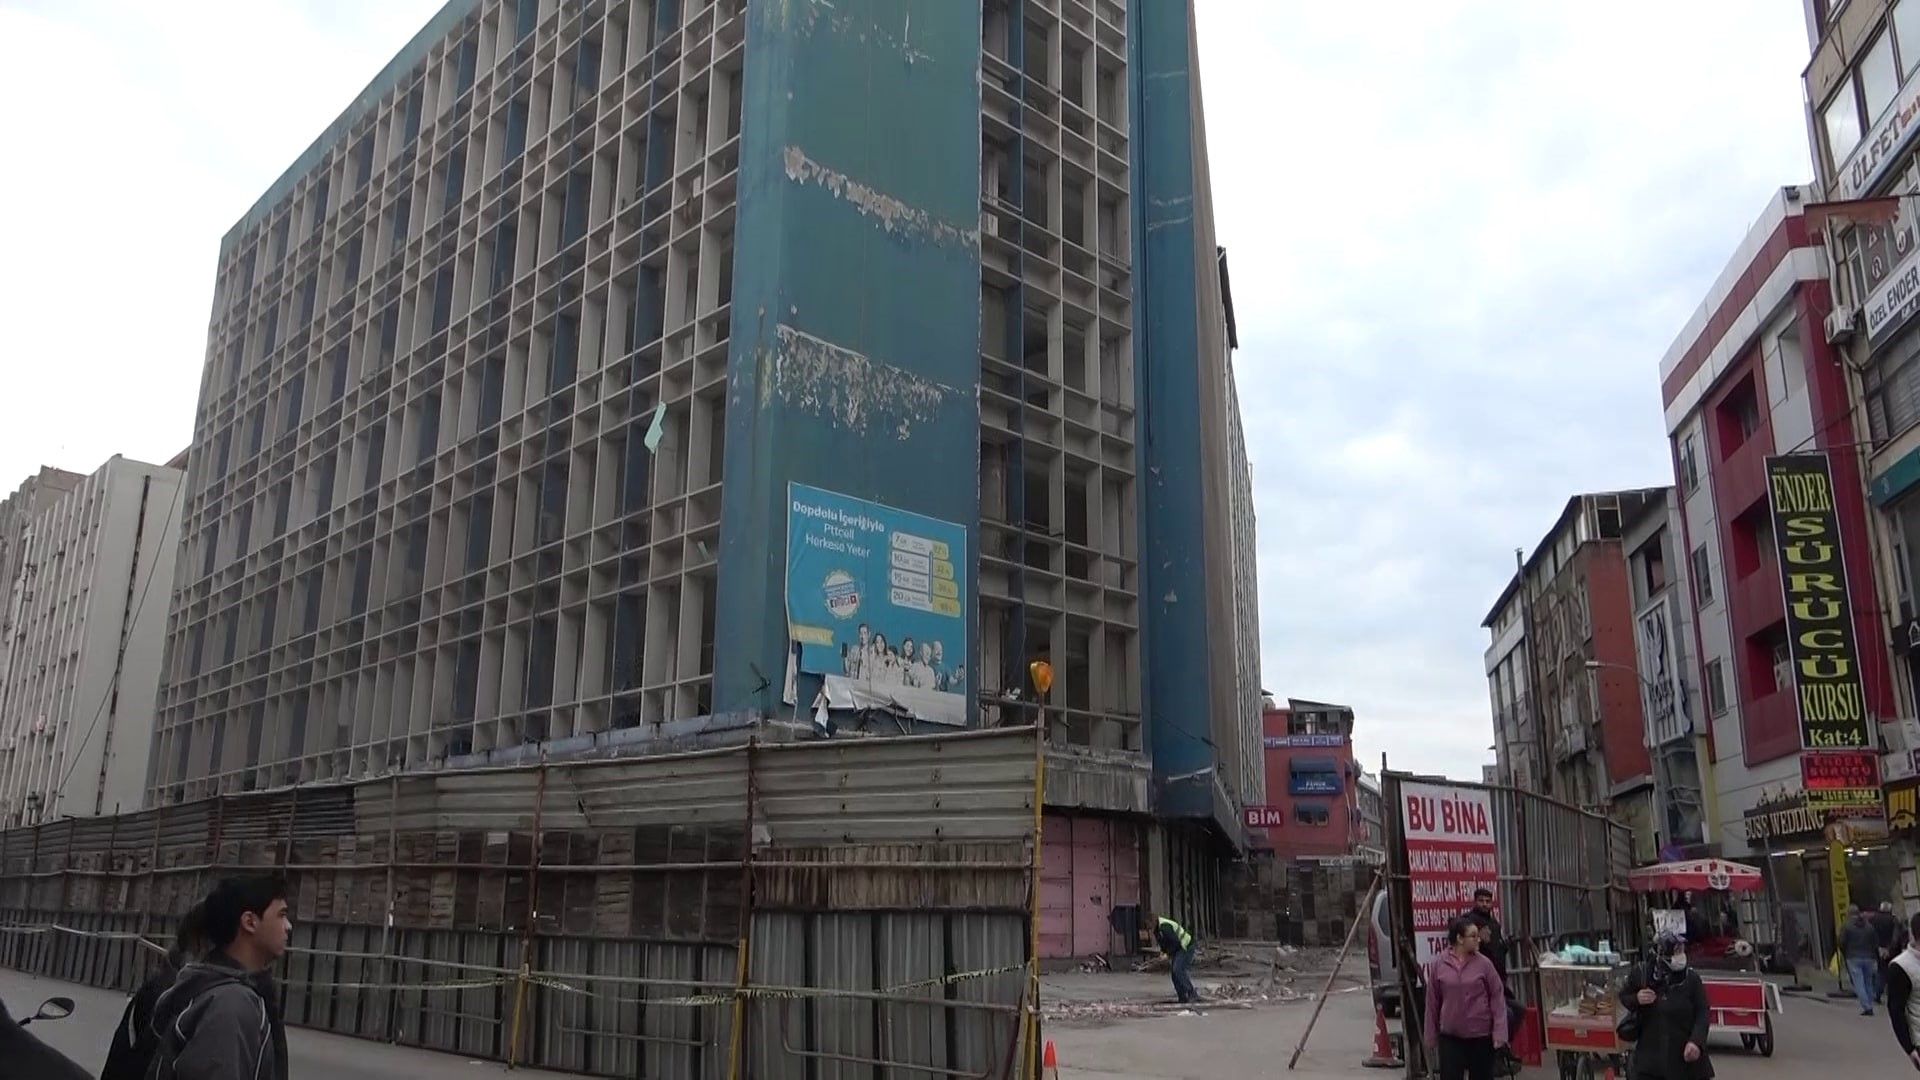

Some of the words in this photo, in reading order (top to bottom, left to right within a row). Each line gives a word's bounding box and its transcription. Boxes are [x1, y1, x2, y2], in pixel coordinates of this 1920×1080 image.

[1887, 266, 1920, 312] ENDER
[1772, 473, 1832, 512] ENDER
[792, 500, 838, 523] Dopdolu
[805, 533, 845, 554] Herkese
[846, 543, 871, 559] Yeter
[1782, 516, 1851, 679] SÜRÜCÜ
[1800, 682, 1861, 721] KURSU
[1808, 728, 1862, 747] Kat:4
[1248, 809, 1281, 825] BİM
[1407, 795, 1435, 832] BU
[1441, 792, 1489, 836] BİNA
[1771, 808, 1825, 836] WEDDING
